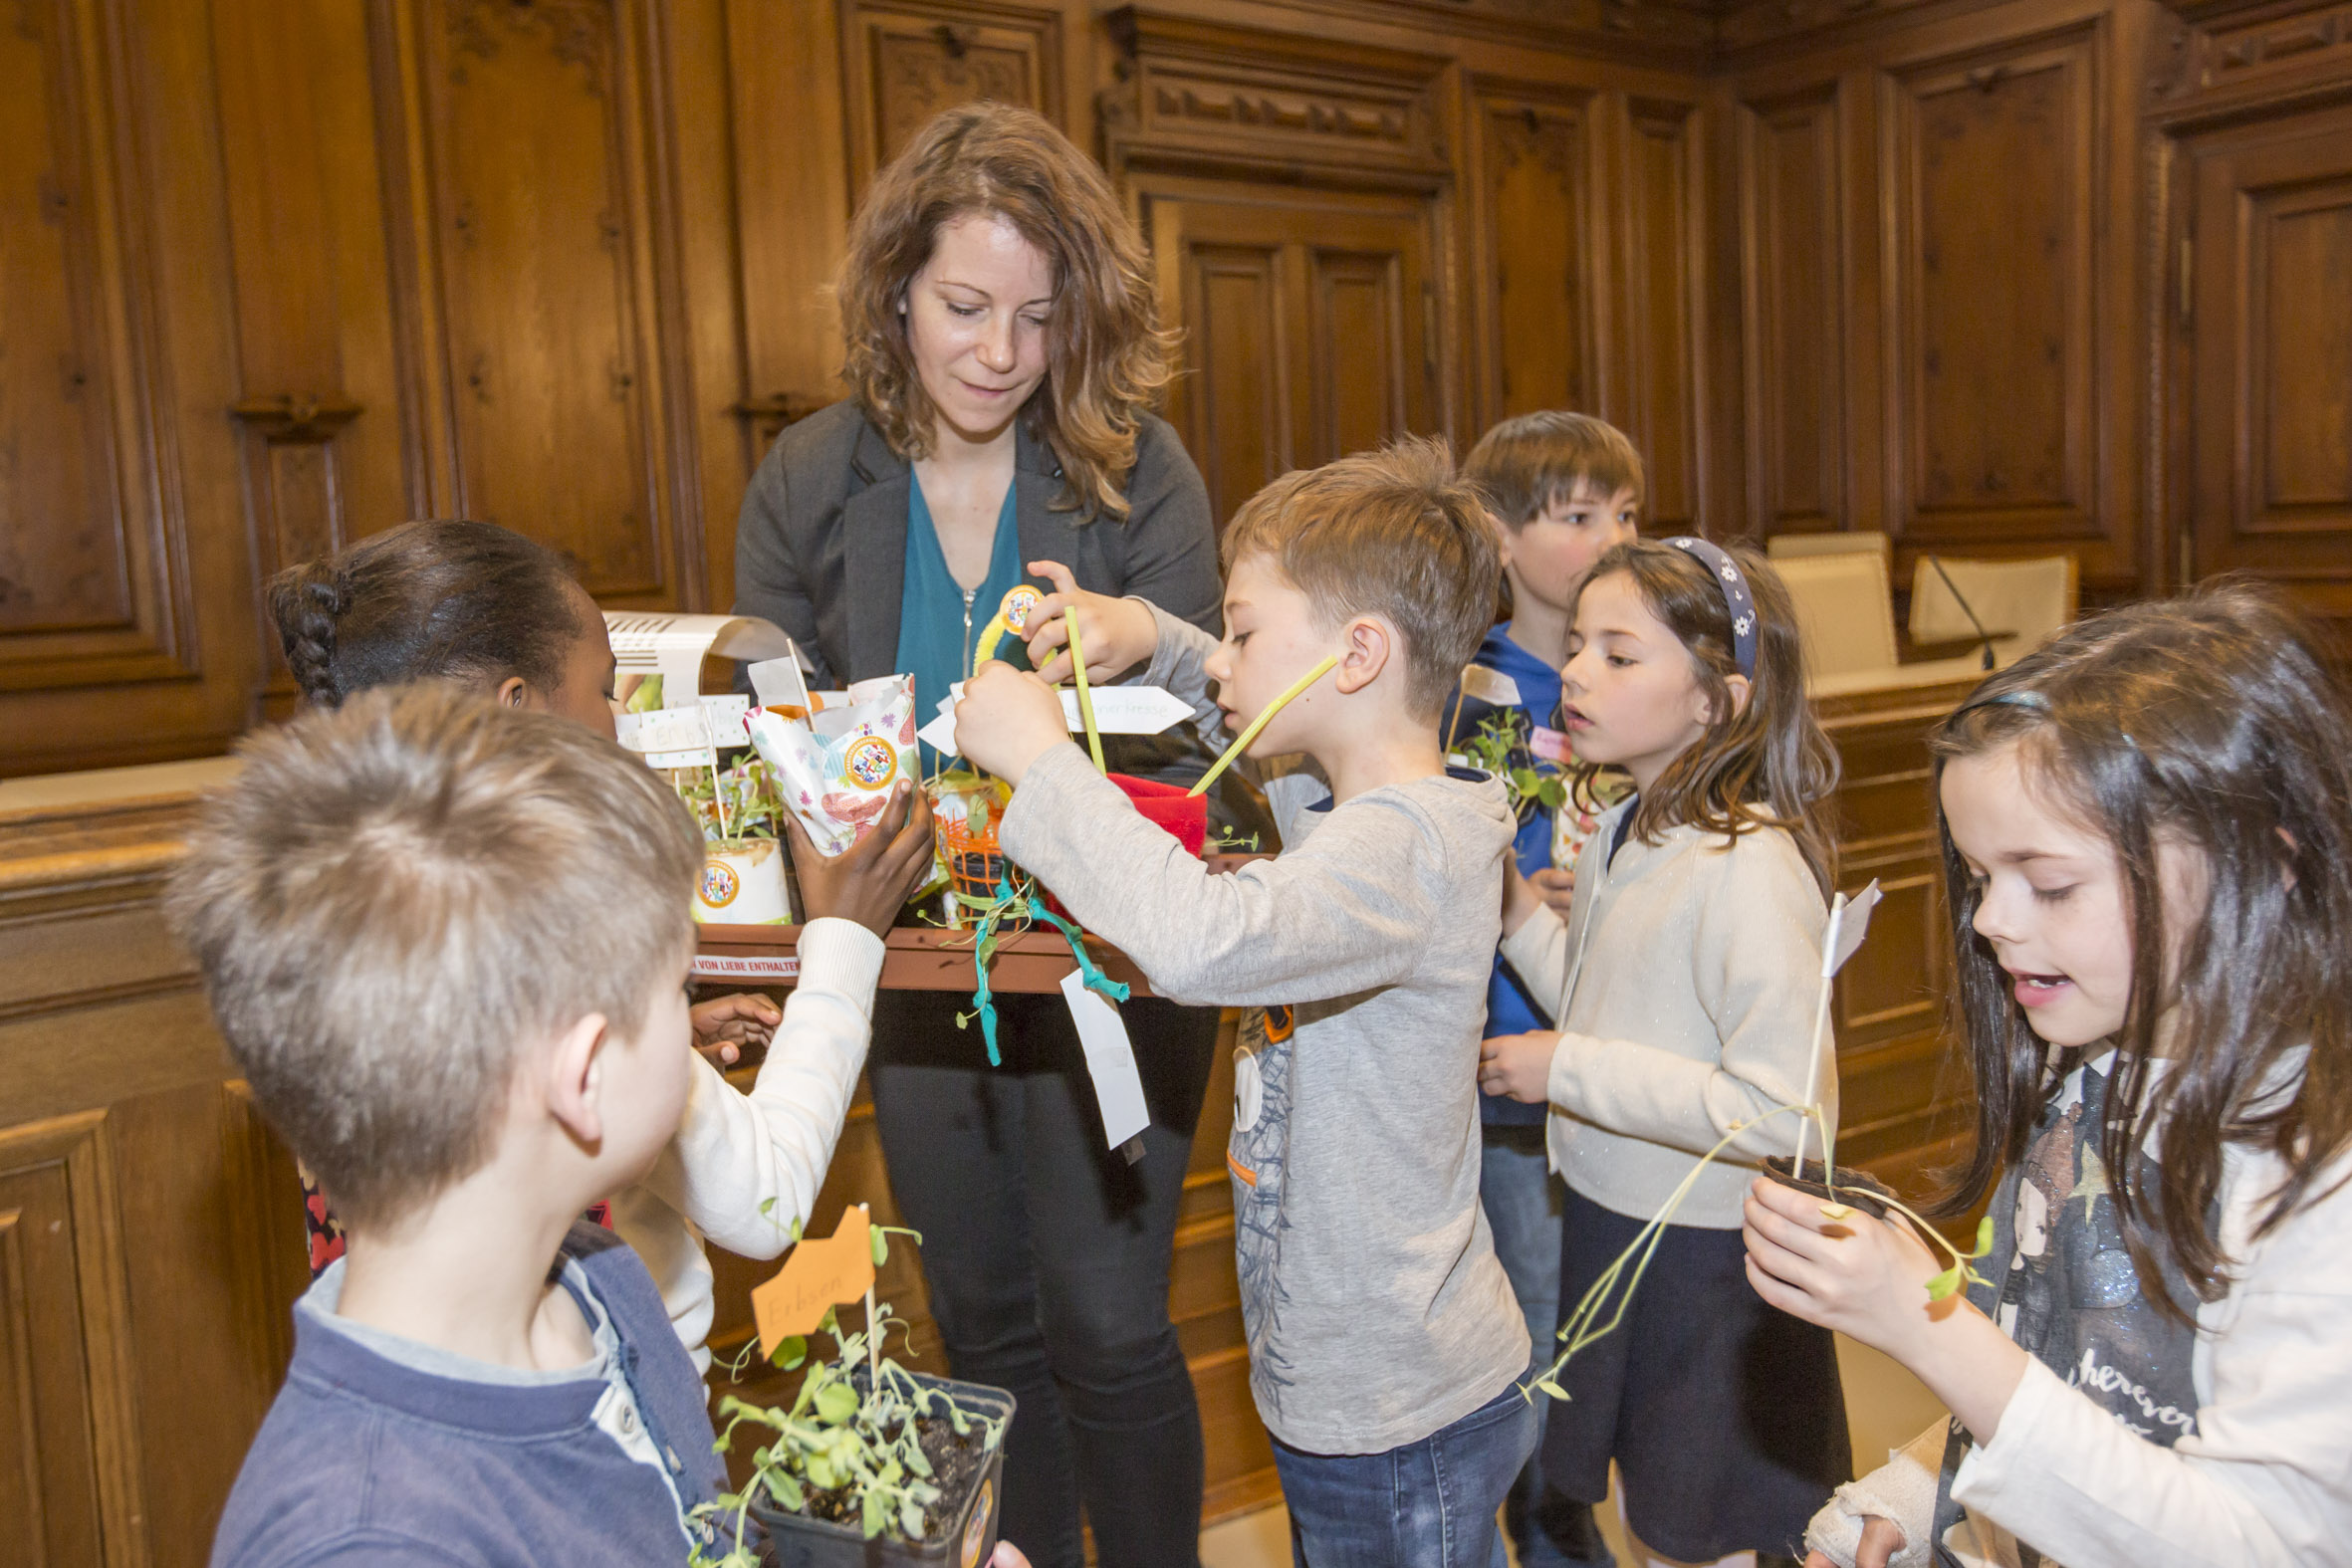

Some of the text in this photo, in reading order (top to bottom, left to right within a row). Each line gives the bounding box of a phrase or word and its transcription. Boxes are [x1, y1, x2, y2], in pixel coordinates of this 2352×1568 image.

[698, 960, 719, 971] VON
[720, 961, 747, 972] LIEBE
[768, 1275, 842, 1329] Erbsen
